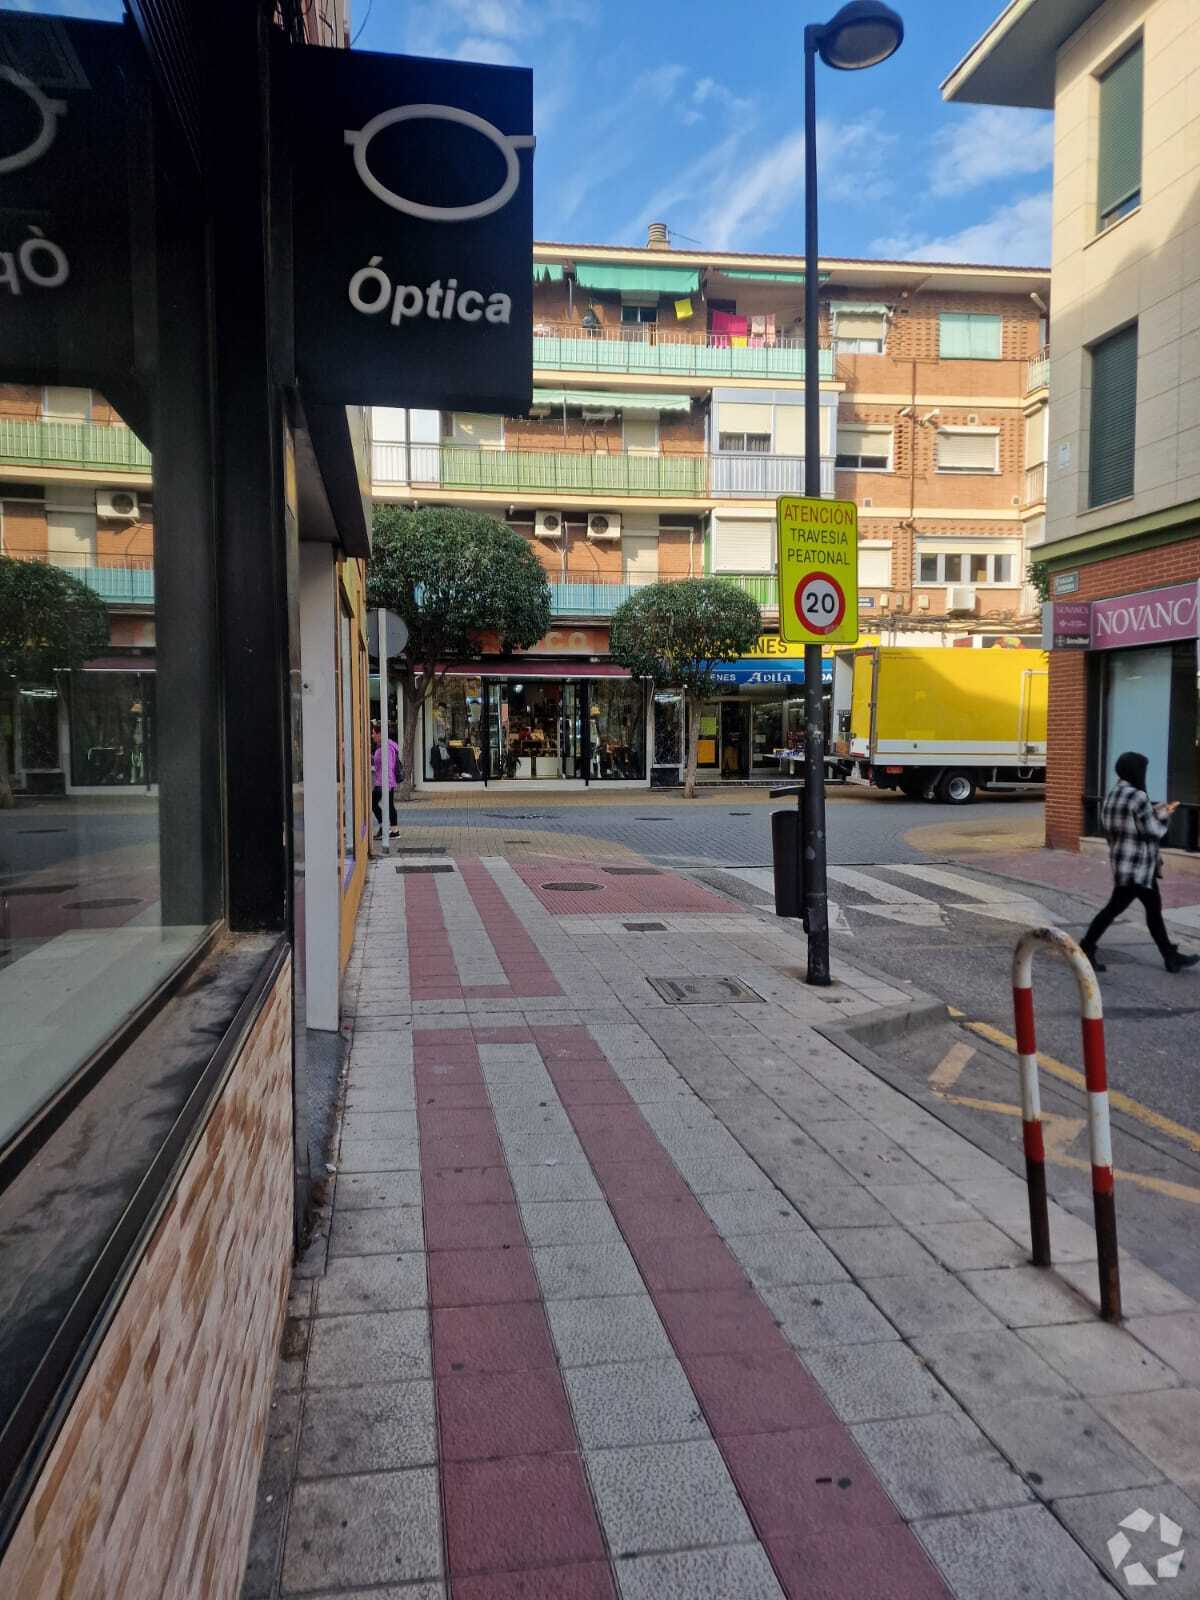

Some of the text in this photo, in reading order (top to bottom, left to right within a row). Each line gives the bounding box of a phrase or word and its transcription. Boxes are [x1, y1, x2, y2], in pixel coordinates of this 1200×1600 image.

[349, 256, 512, 326] Óptica
[790, 528, 848, 545] TRAVESIA
[787, 548, 850, 566] PEATONAL
[806, 592, 835, 614] 20
